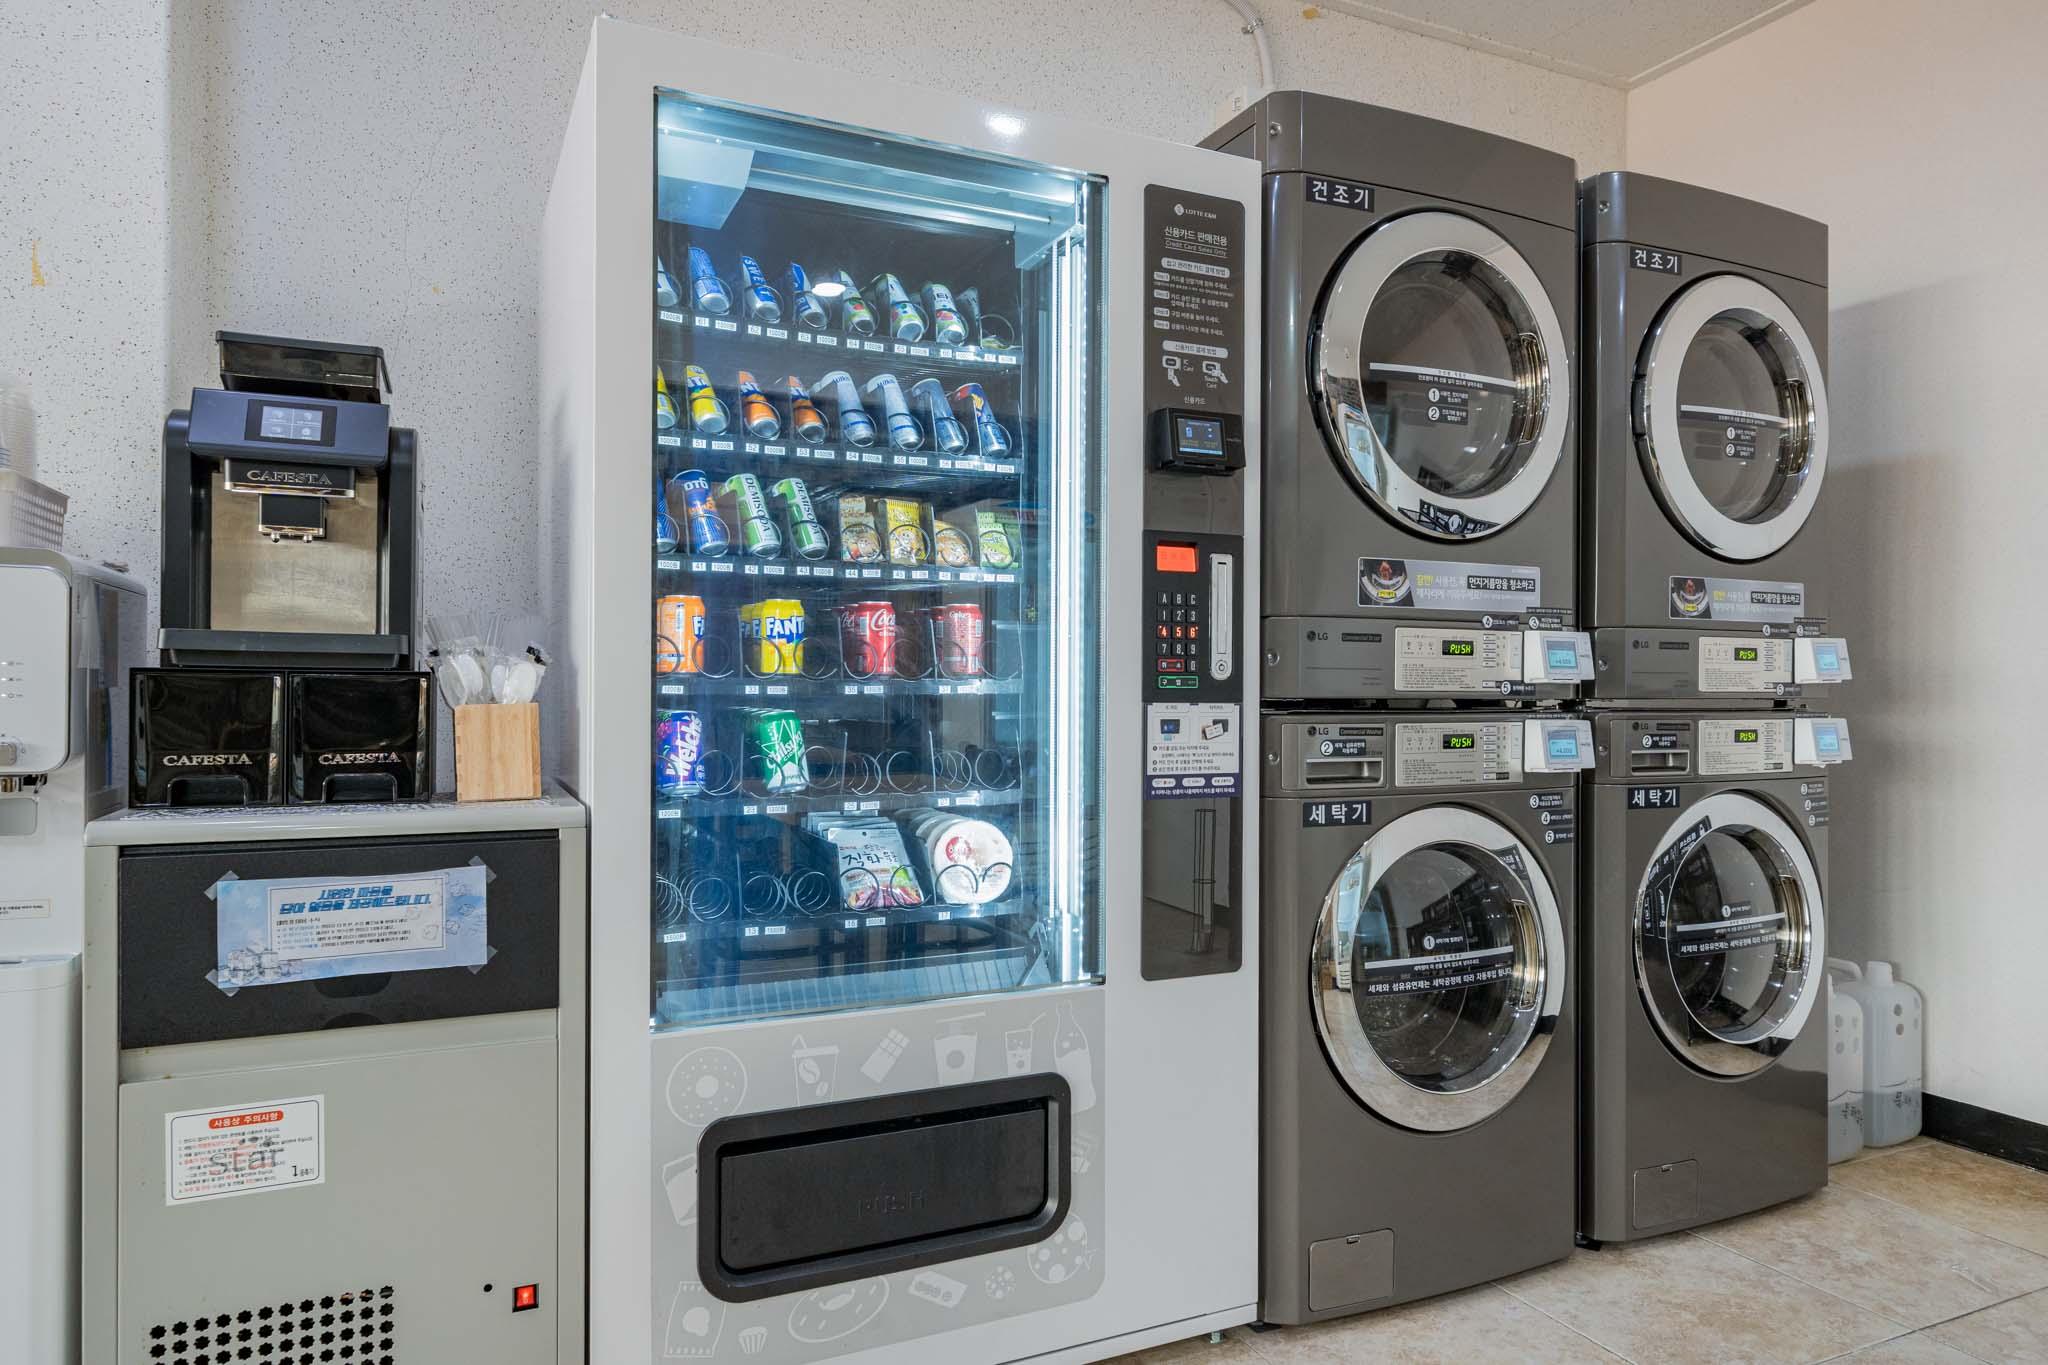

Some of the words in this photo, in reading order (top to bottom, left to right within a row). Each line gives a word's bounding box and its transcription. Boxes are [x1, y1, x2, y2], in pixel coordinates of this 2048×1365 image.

[1312, 180, 1369, 210] 건조기
[1185, 209, 1203, 217] LOTTE
[1165, 226, 1196, 240] 신용카드
[1197, 232, 1228, 247] 판매전용
[1635, 250, 1678, 273] 건조기
[695, 440, 705, 448] 51
[246, 470, 333, 485] CAFESTA
[745, 477, 771, 532] DEMISODA
[795, 481, 821, 535] DEMISODA
[1469, 577, 1507, 590] 먼지거름망을
[1508, 580, 1534, 591] 청소하고
[1162, 593, 1168, 604] A
[1162, 610, 1167, 621] 1
[1176, 611, 1182, 621] 2
[1190, 611, 1196, 621] 3
[1161, 627, 1168, 638] 4
[1176, 627, 1182, 638] 5
[1190, 628, 1196, 638] 6
[1317, 633, 1329, 642] LG
[1162, 643, 1168, 654] 7
[1176, 643, 1182, 654] 8
[1190, 644, 1196, 655] 9
[1449, 644, 1472, 655] PUSH
[1738, 650, 1756, 660] PUSH
[1318, 727, 1329, 735] LG
[1739, 732, 1756, 741] PUSH
[666, 713, 703, 778] Welch's
[1450, 738, 1471, 748] PUSH
[162, 752, 252, 767] CAFESTA
[318, 750, 402, 766] CAFESTA
[1632, 789, 1678, 807] 세탁기
[1308, 802, 1368, 825] 세탁기
[1369, 983, 1389, 994] 세제와
[1391, 980, 1430, 993] 섬유유연제는
[1432, 976, 1462, 988] 세탁공정에
[1463, 974, 1475, 983] 따라
[1476, 971, 1497, 981] 자동투입
[214, 1118, 240, 1127] 사용상
[243, 1112, 278, 1124] 주의사항
